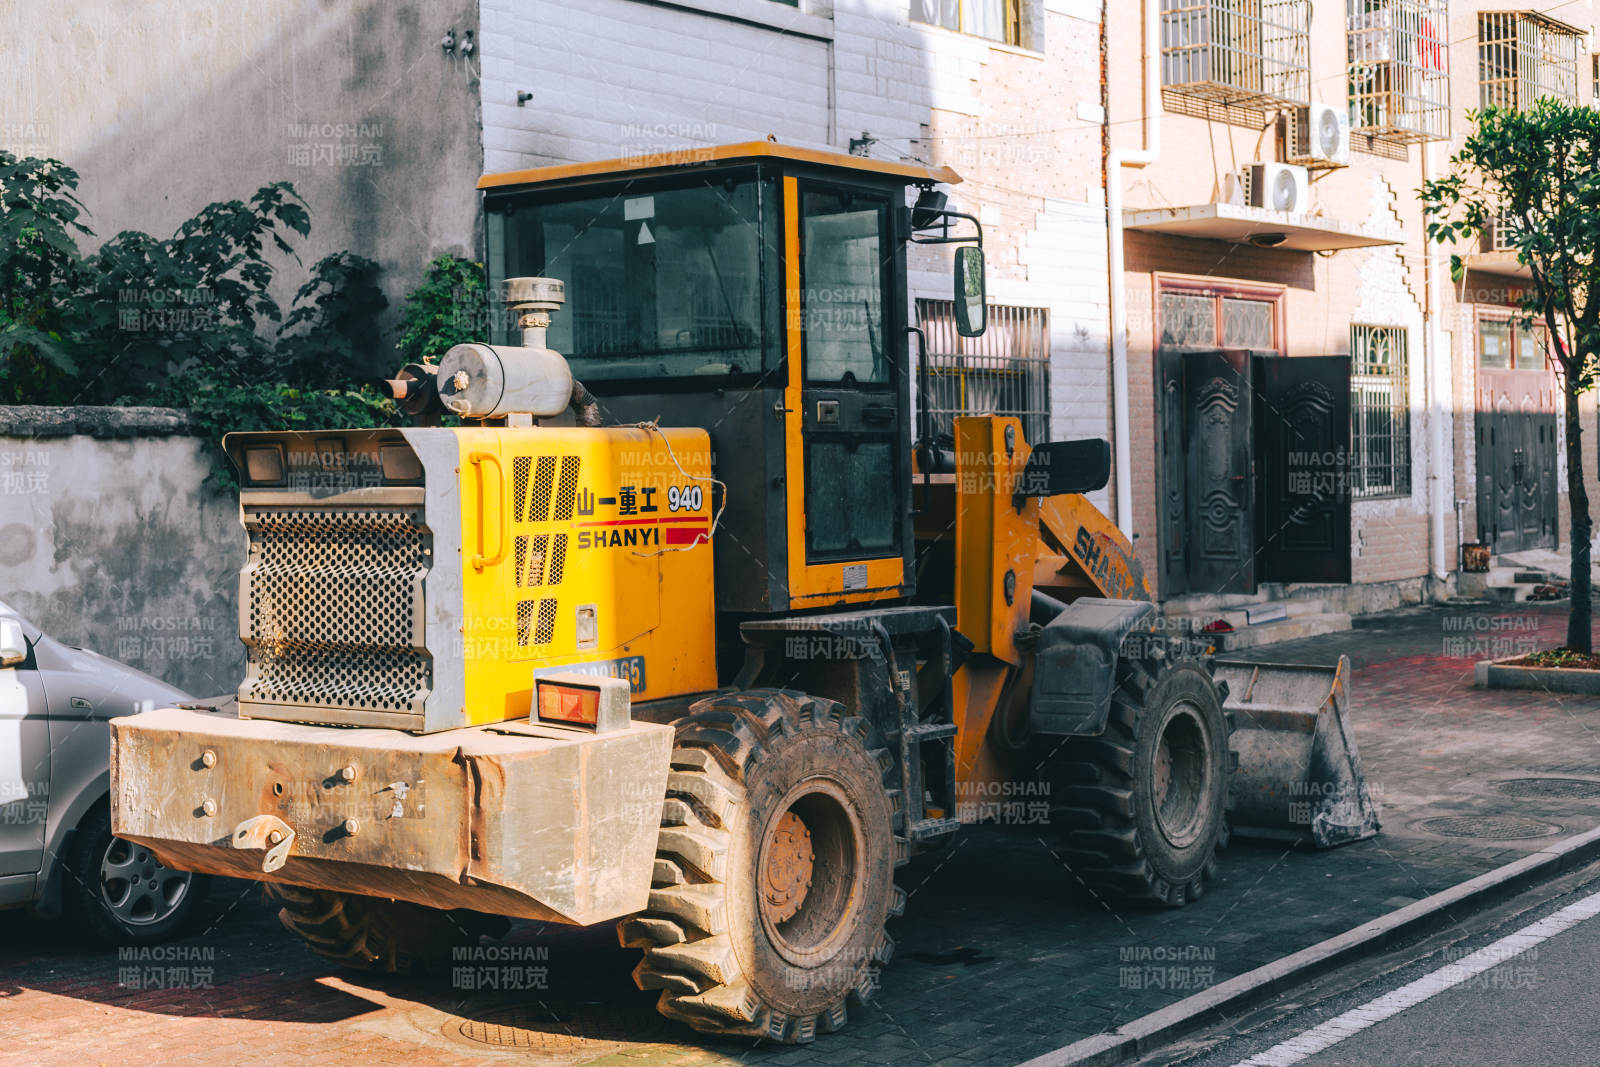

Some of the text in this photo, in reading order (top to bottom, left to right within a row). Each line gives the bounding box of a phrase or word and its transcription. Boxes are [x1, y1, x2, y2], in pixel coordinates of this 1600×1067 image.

[577, 485, 703, 516] 山一重工 940
[577, 527, 659, 549] SHANYI
